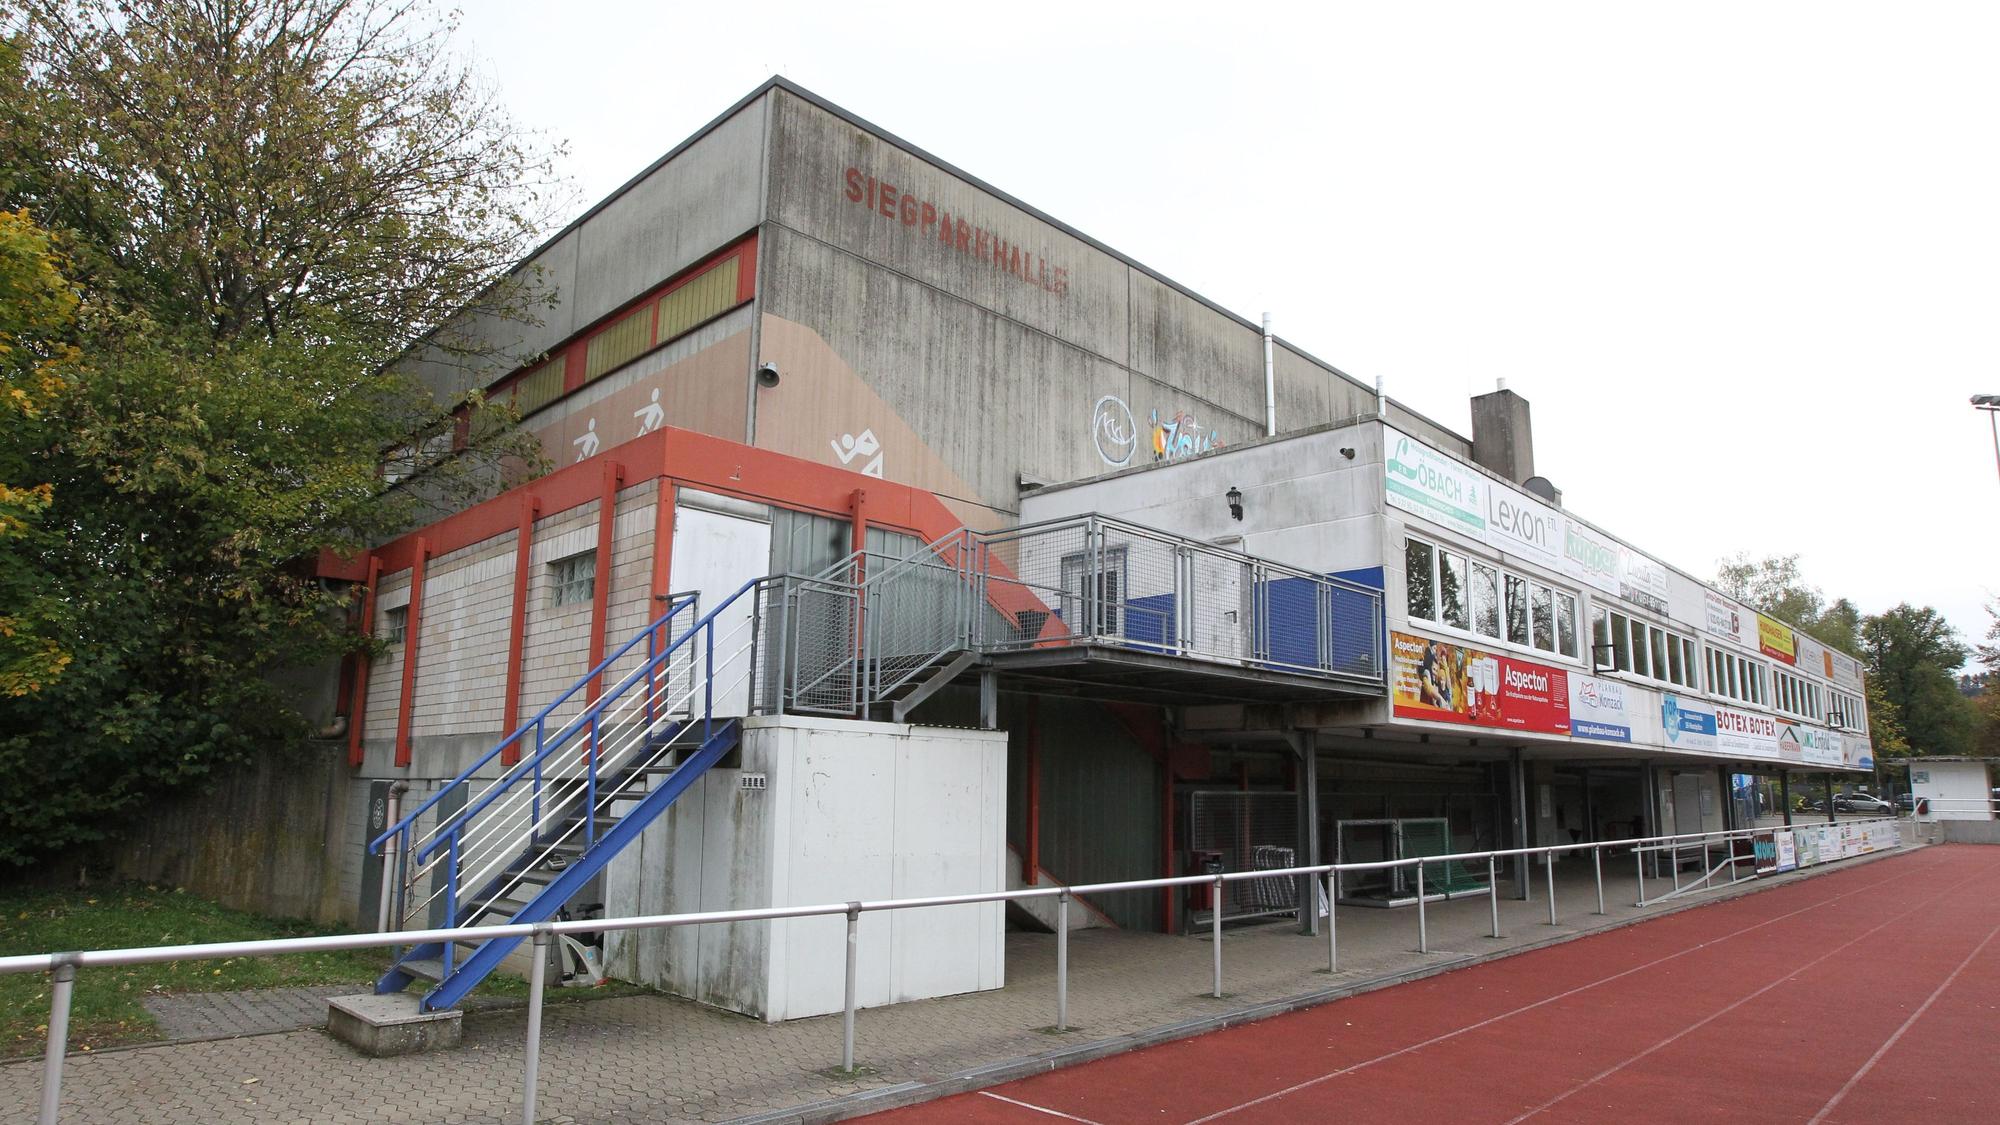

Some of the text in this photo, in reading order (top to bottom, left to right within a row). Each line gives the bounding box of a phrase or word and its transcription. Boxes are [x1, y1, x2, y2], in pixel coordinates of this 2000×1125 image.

[845, 167, 1070, 299] SIEGPARKHALLE
[1488, 485, 1546, 547] Lexon
[1505, 664, 1548, 692] Aspecton
[1716, 710, 1748, 733] BOTEX
[1749, 716, 1776, 737] BOTEX
